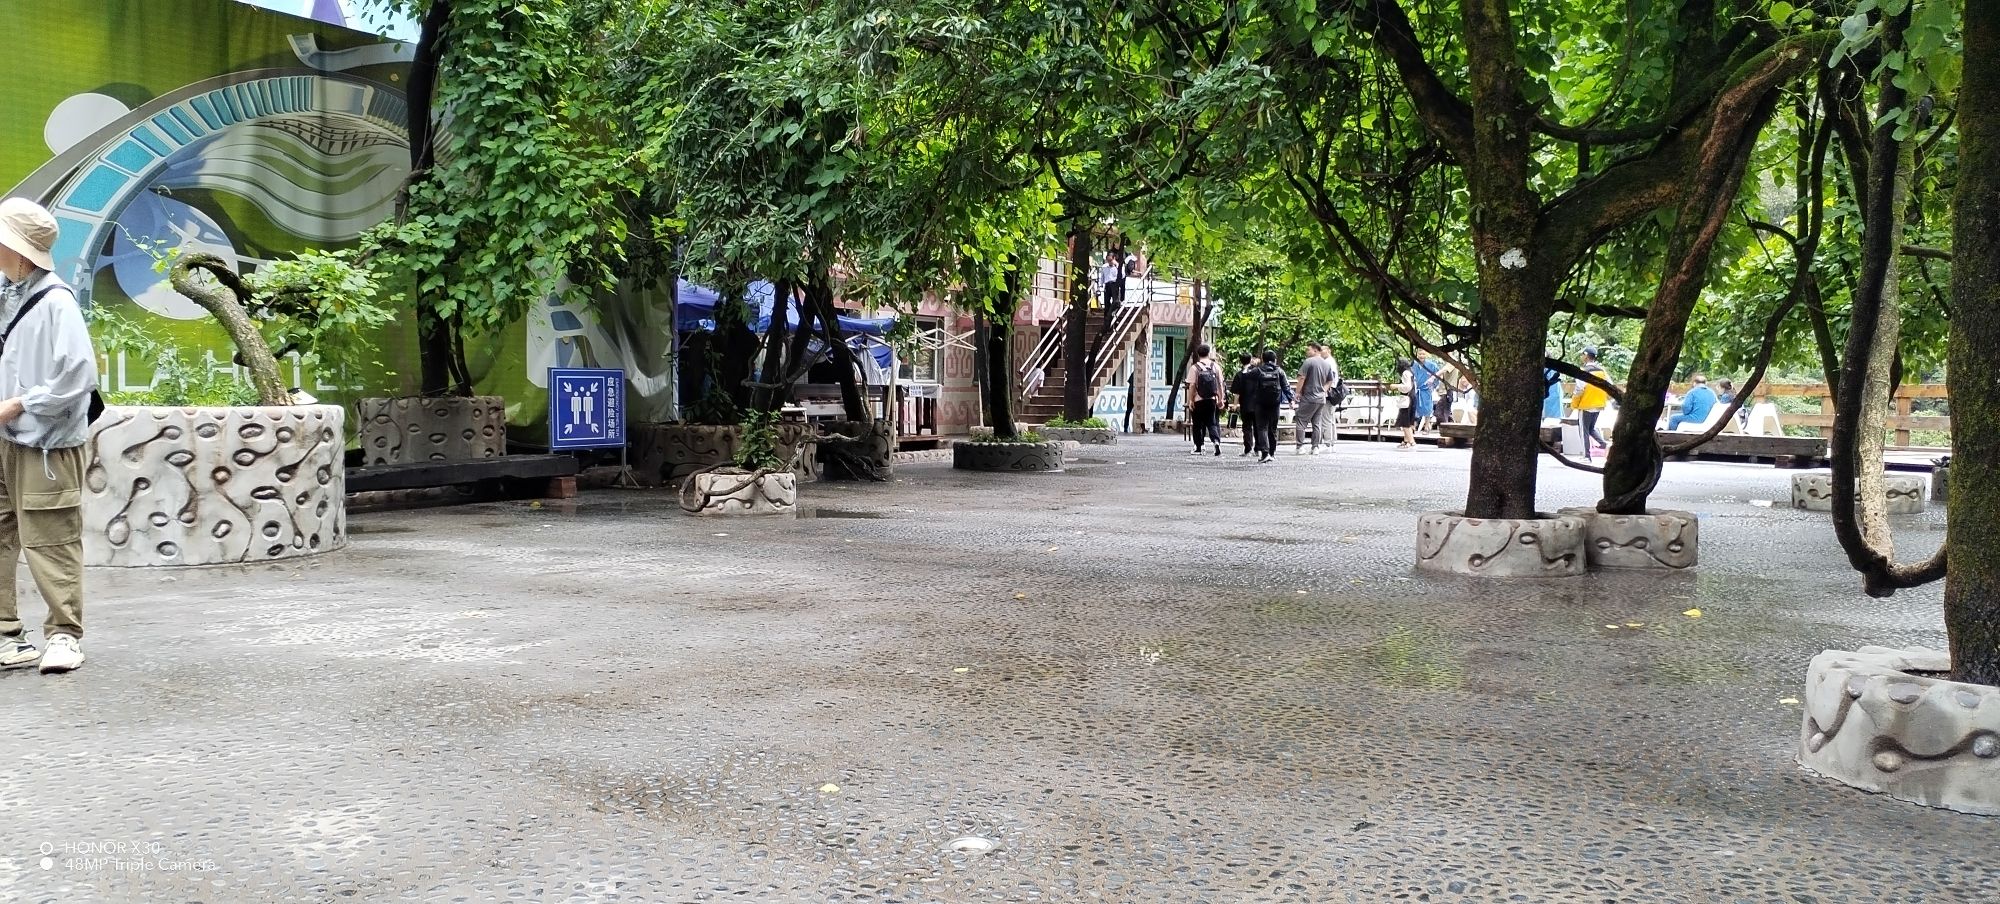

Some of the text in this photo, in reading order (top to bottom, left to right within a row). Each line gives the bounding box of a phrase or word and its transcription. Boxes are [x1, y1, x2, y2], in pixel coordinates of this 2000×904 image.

[607, 376, 615, 439] 应急避险场所
